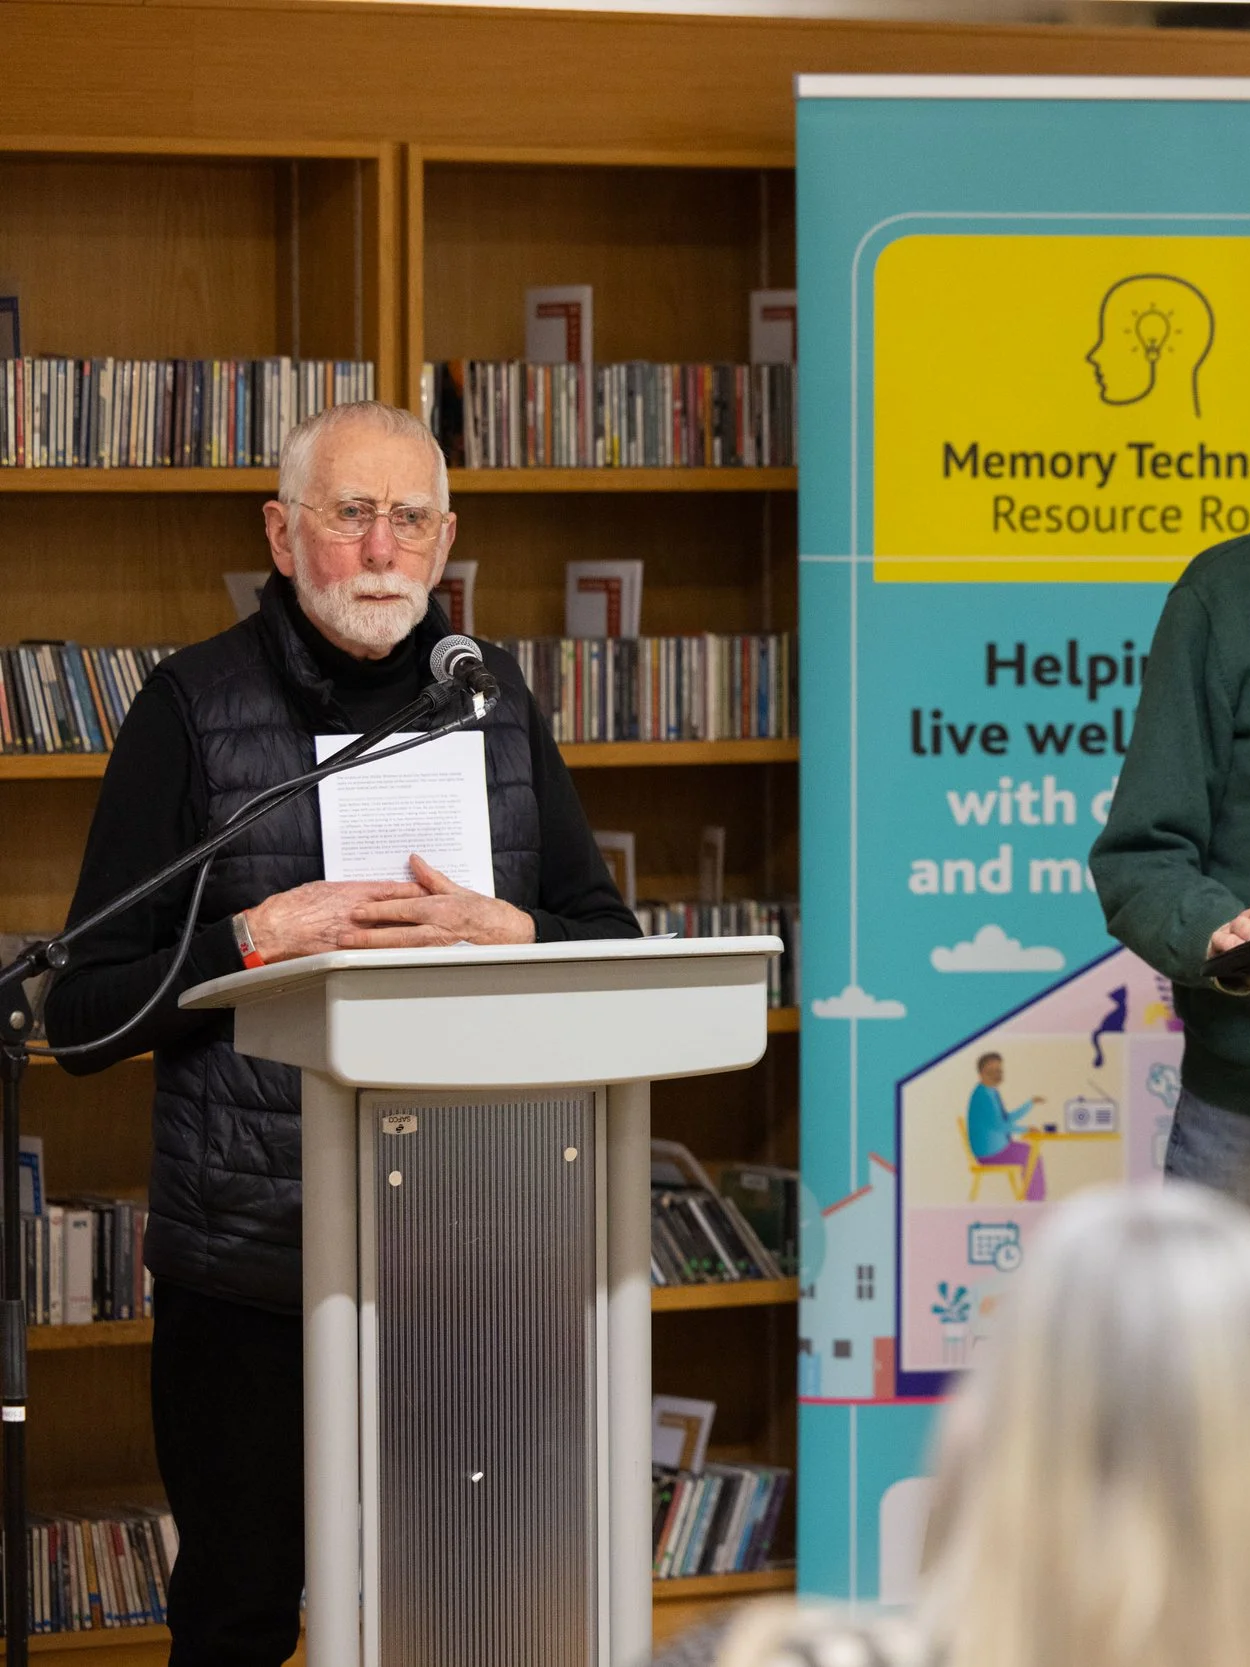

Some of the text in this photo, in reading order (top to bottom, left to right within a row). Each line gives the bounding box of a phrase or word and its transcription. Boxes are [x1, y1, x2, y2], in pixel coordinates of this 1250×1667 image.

[943, 441, 1117, 488] Memory
[992, 494, 1182, 534] Resource
[911, 708, 1134, 756] live wel
[947, 775, 1077, 826] with
[908, 844, 1013, 895] and
[388, 1115, 411, 1123] SAFCO
